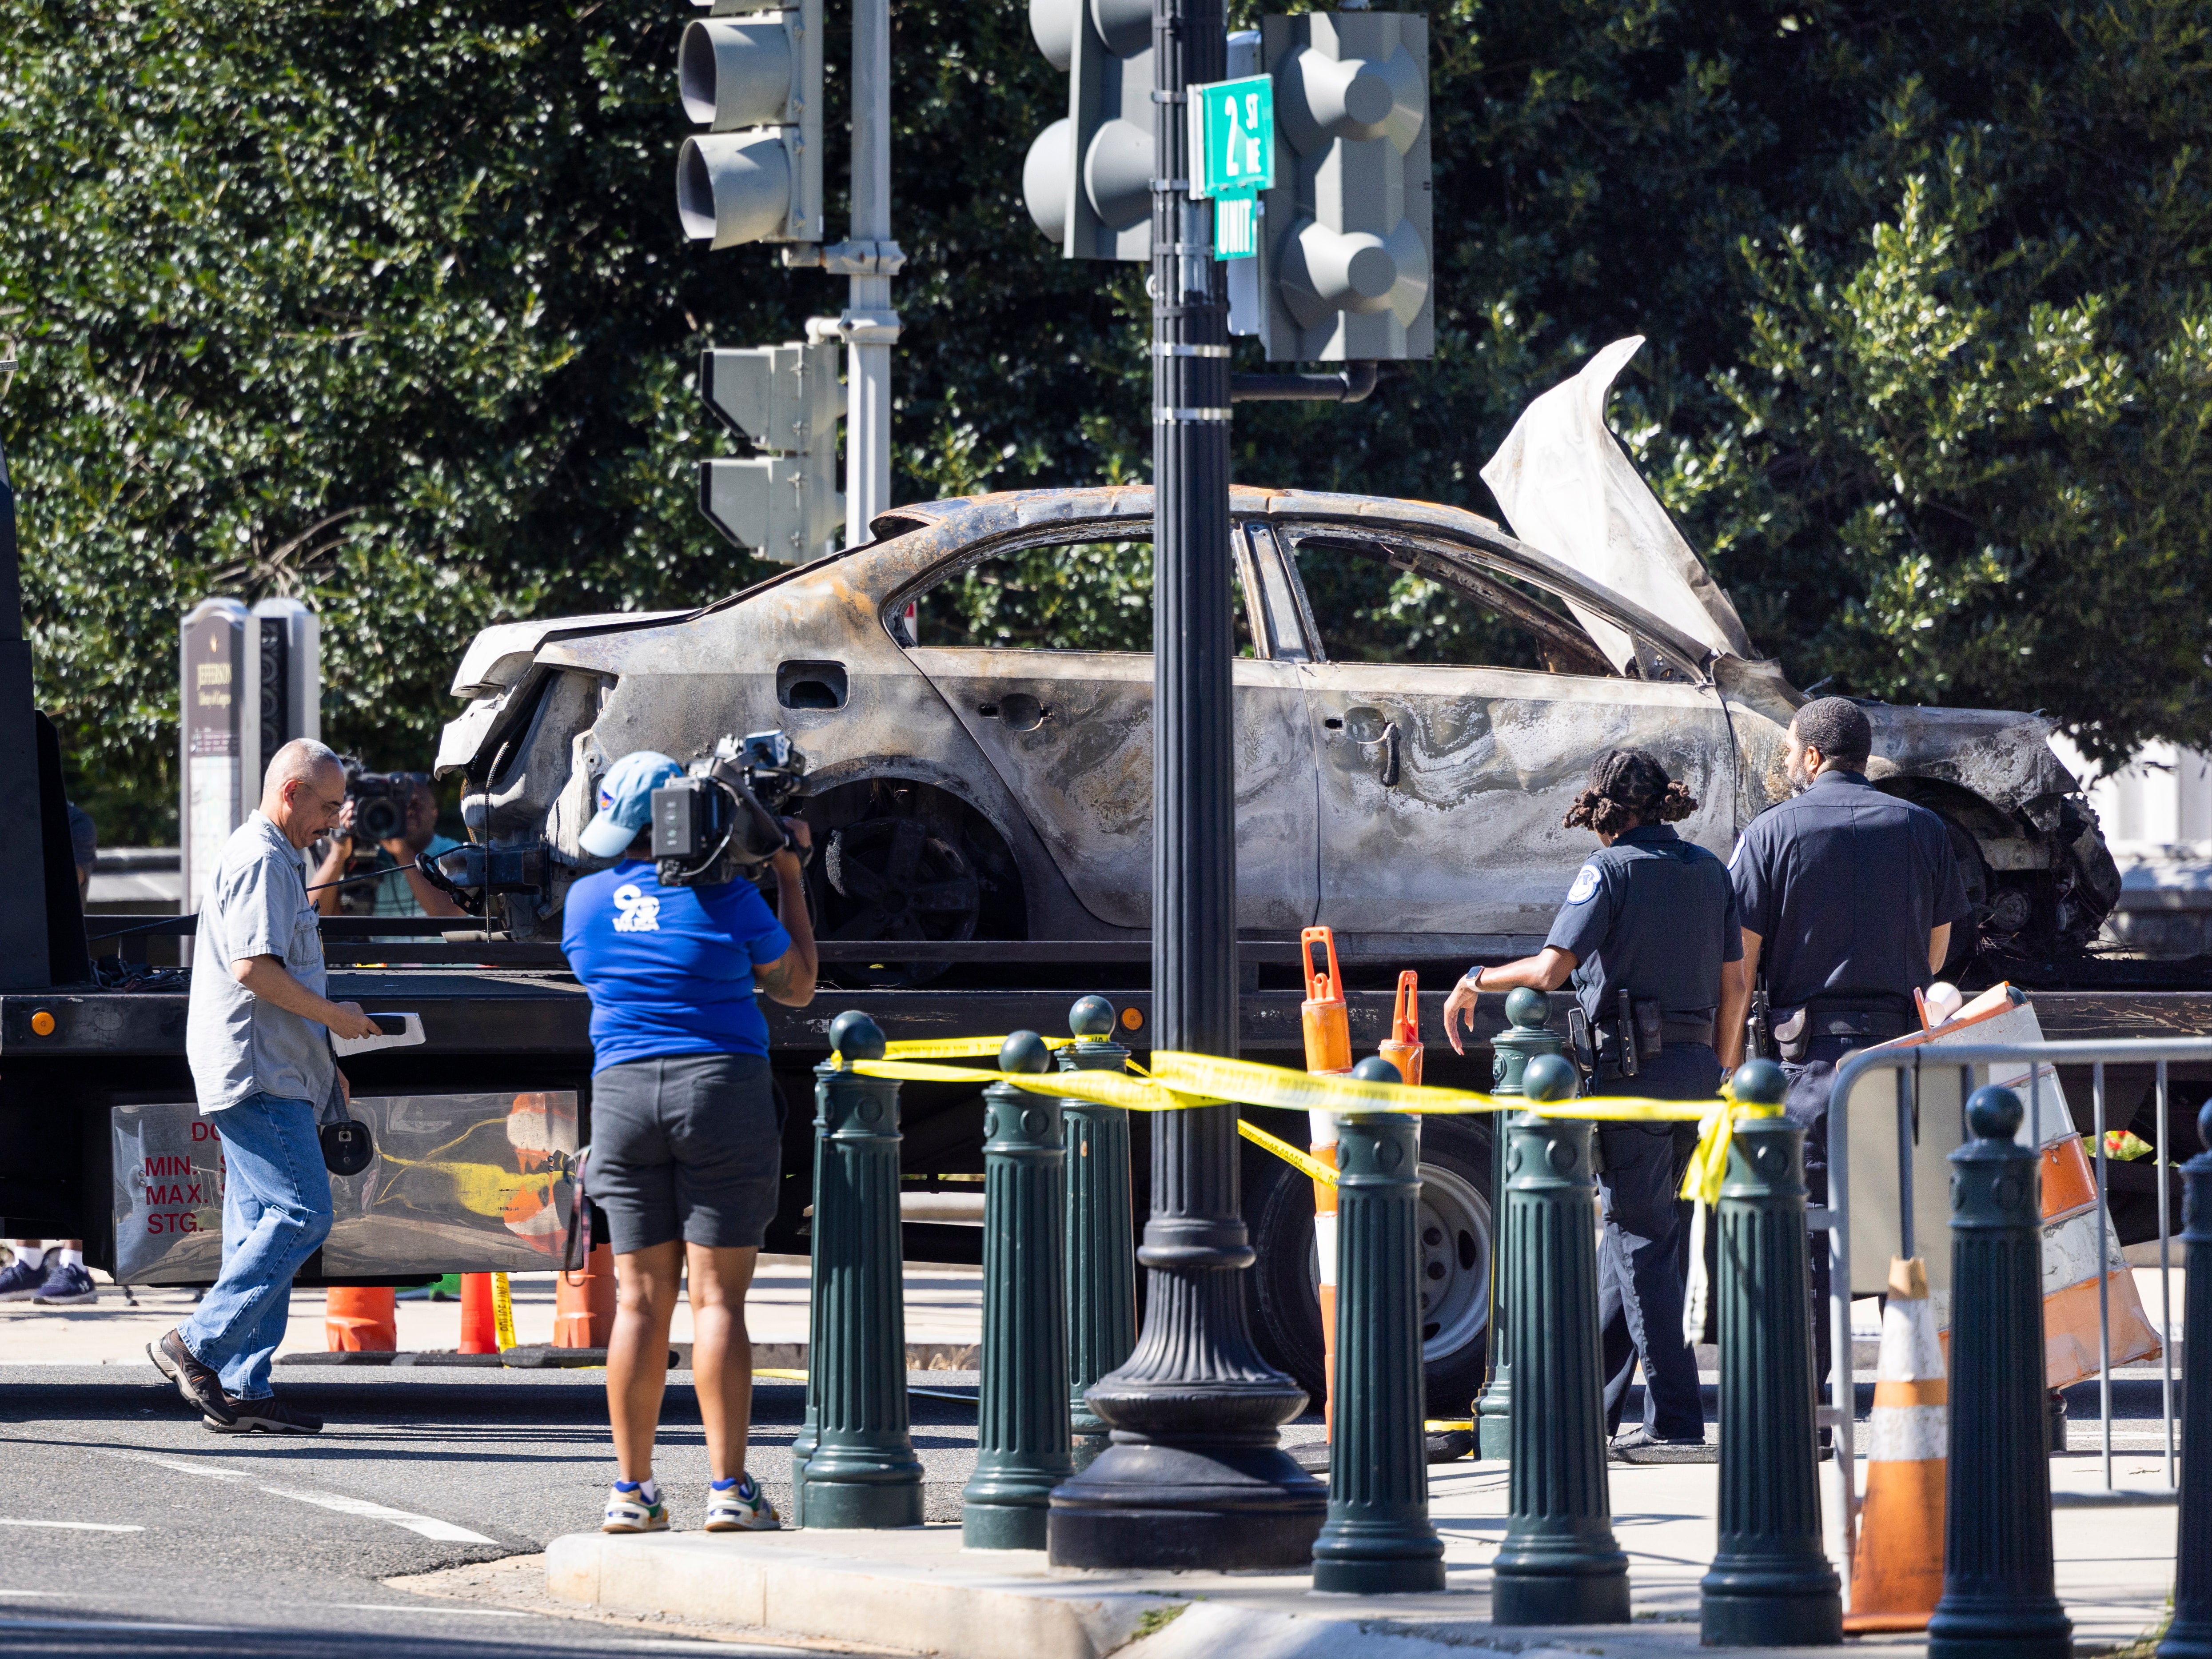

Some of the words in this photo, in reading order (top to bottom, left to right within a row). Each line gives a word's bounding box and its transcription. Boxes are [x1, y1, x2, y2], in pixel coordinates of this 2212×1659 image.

[1225, 95, 1239, 177] 2
[1245, 93, 1259, 130] ST
[1246, 136, 1261, 174] NE
[1218, 199, 1252, 255] UNIT
[145, 1156, 197, 1177] MIN.
[146, 1184, 208, 1205] MAX.
[147, 1212, 204, 1234] STG.
